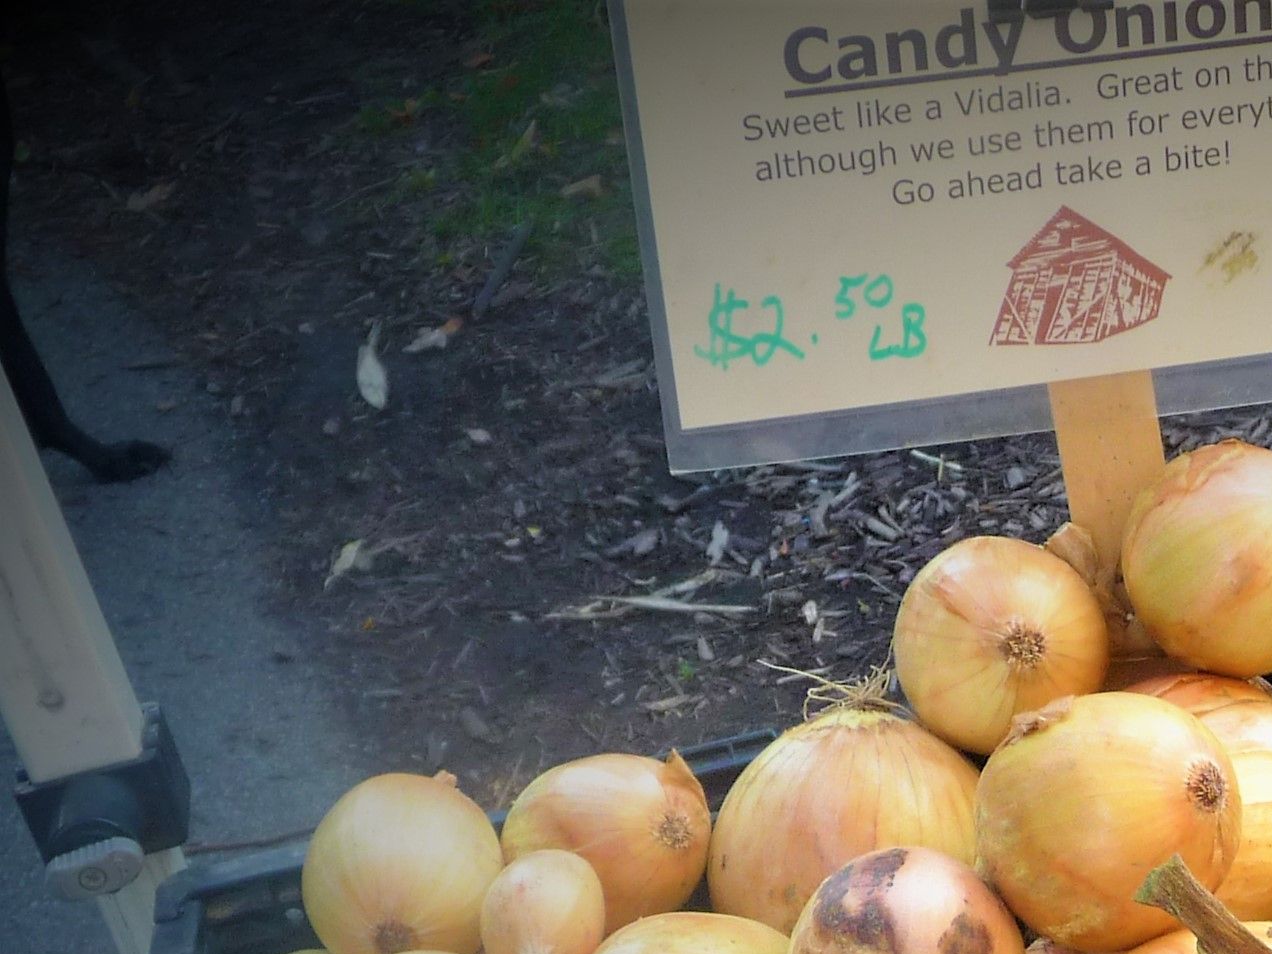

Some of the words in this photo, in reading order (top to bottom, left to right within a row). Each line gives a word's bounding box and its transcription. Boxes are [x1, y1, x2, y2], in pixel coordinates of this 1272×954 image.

[783, 8, 1025, 85] Candy
[743, 106, 845, 141] Sweet
[857, 99, 912, 128] like
[925, 100, 942, 120] a
[955, 81, 1071, 116] Vidalia.
[1097, 66, 1183, 100] Great
[1195, 64, 1231, 88] on
[756, 141, 897, 181] although
[910, 139, 954, 163] we
[968, 131, 1022, 156] use
[1035, 121, 1114, 148] them
[1128, 110, 1170, 137] for
[892, 179, 935, 205] Go
[948, 162, 1042, 199] ahead
[1056, 156, 1122, 186] take
[1135, 155, 1151, 176] a
[1165, 140, 1230, 172] bite!
[868, 302, 928, 362] LB
